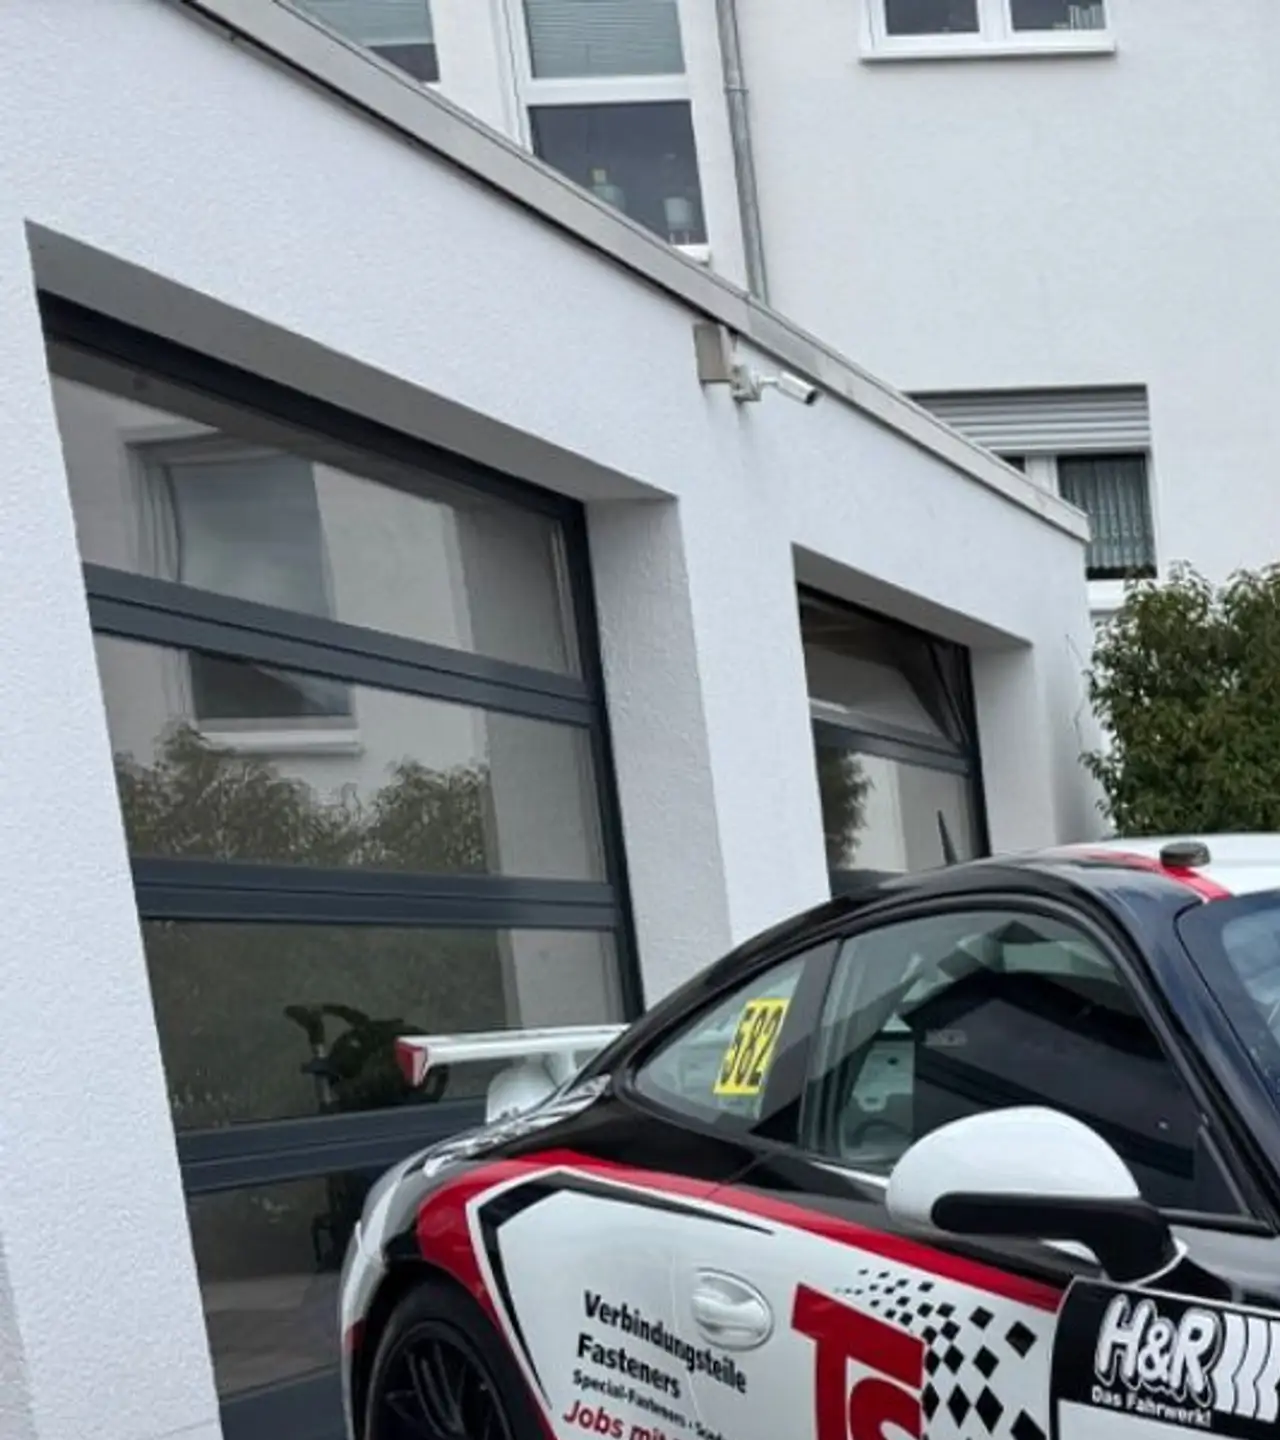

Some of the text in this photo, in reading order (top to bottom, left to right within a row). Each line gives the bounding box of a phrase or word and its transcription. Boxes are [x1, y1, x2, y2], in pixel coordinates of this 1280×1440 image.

[720, 1005, 783, 1087] 582
[577, 1332, 681, 1399] Fasteners
[584, 1289, 747, 1394] Verbindungsteile
[1095, 1294, 1222, 1407] H&R
[562, 1399, 624, 1440] Jobs
